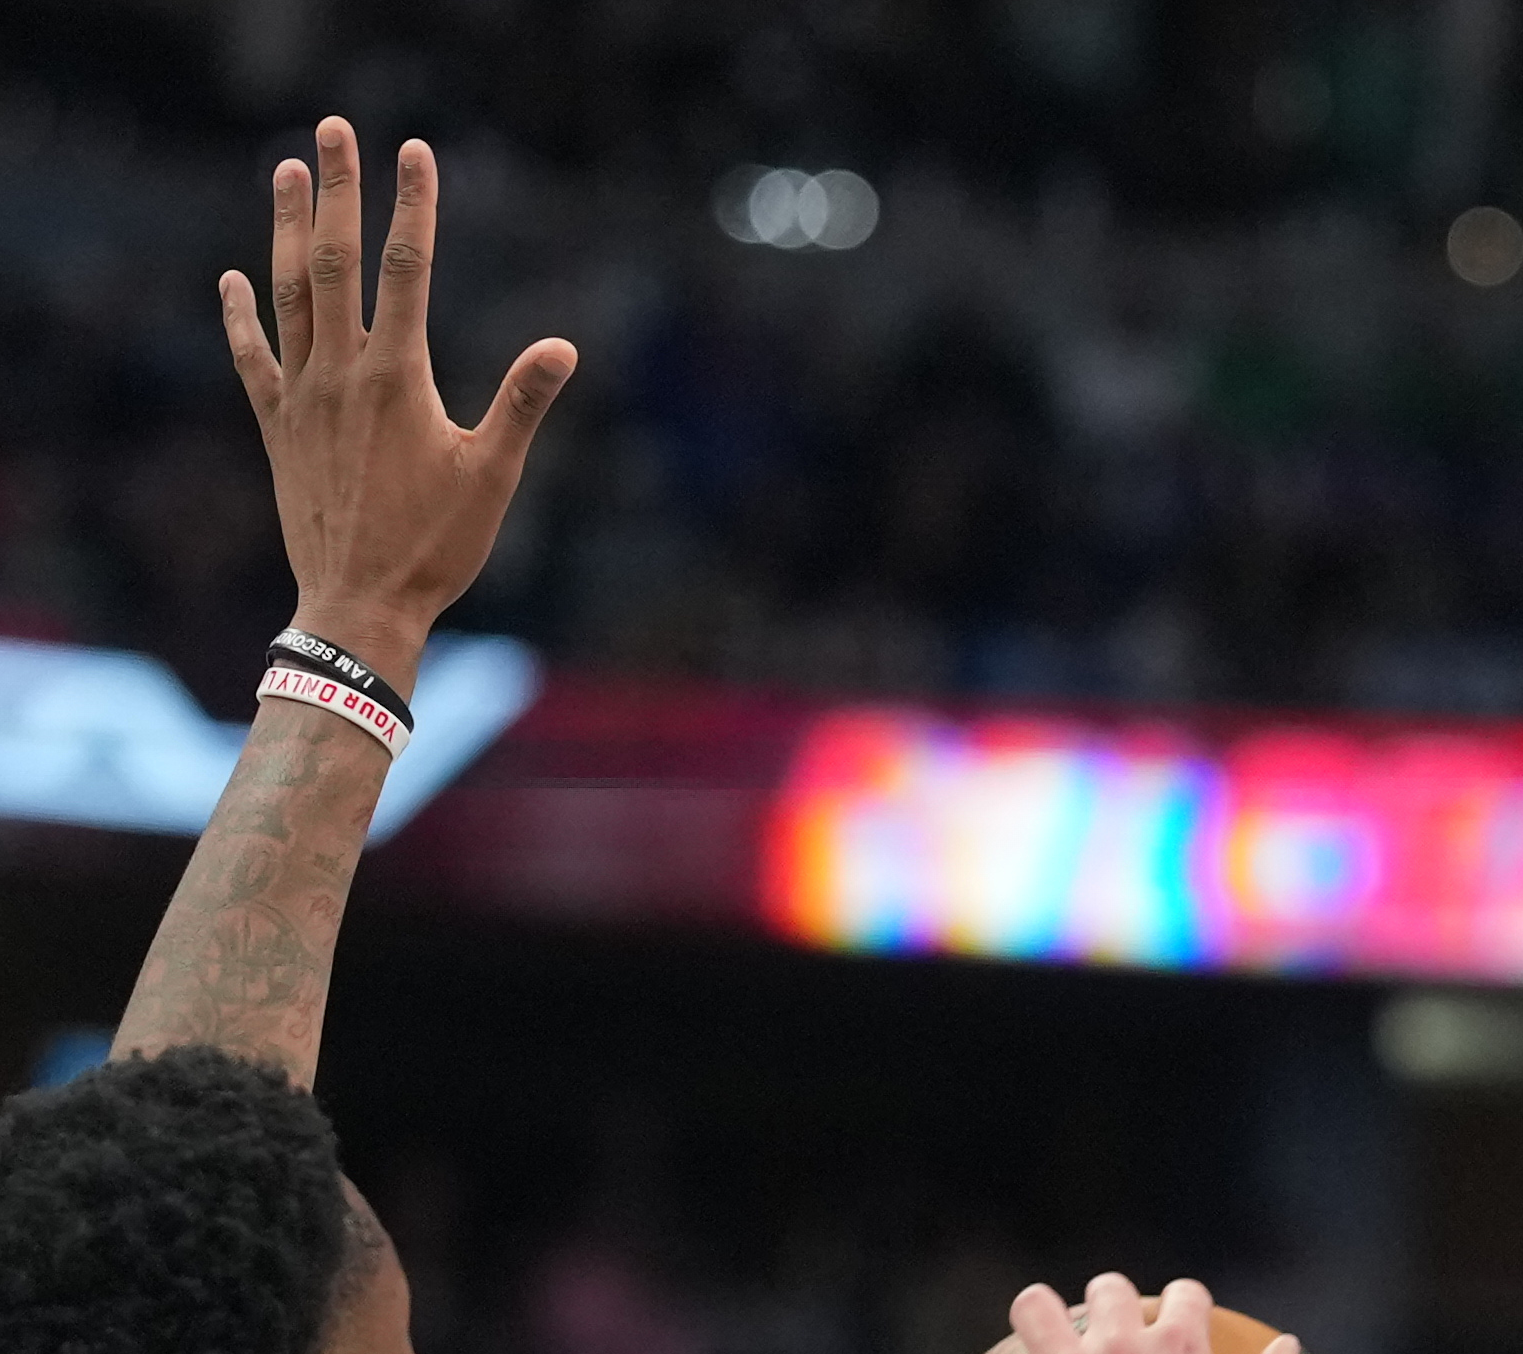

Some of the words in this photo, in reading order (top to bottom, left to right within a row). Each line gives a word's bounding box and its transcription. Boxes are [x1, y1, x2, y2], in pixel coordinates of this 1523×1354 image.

[275, 632, 337, 661] SECOND
[334, 654, 368, 680] AM
[276, 671, 338, 703] ONLY
[362, 675, 375, 689] I
[343, 691, 397, 744] YOUR
